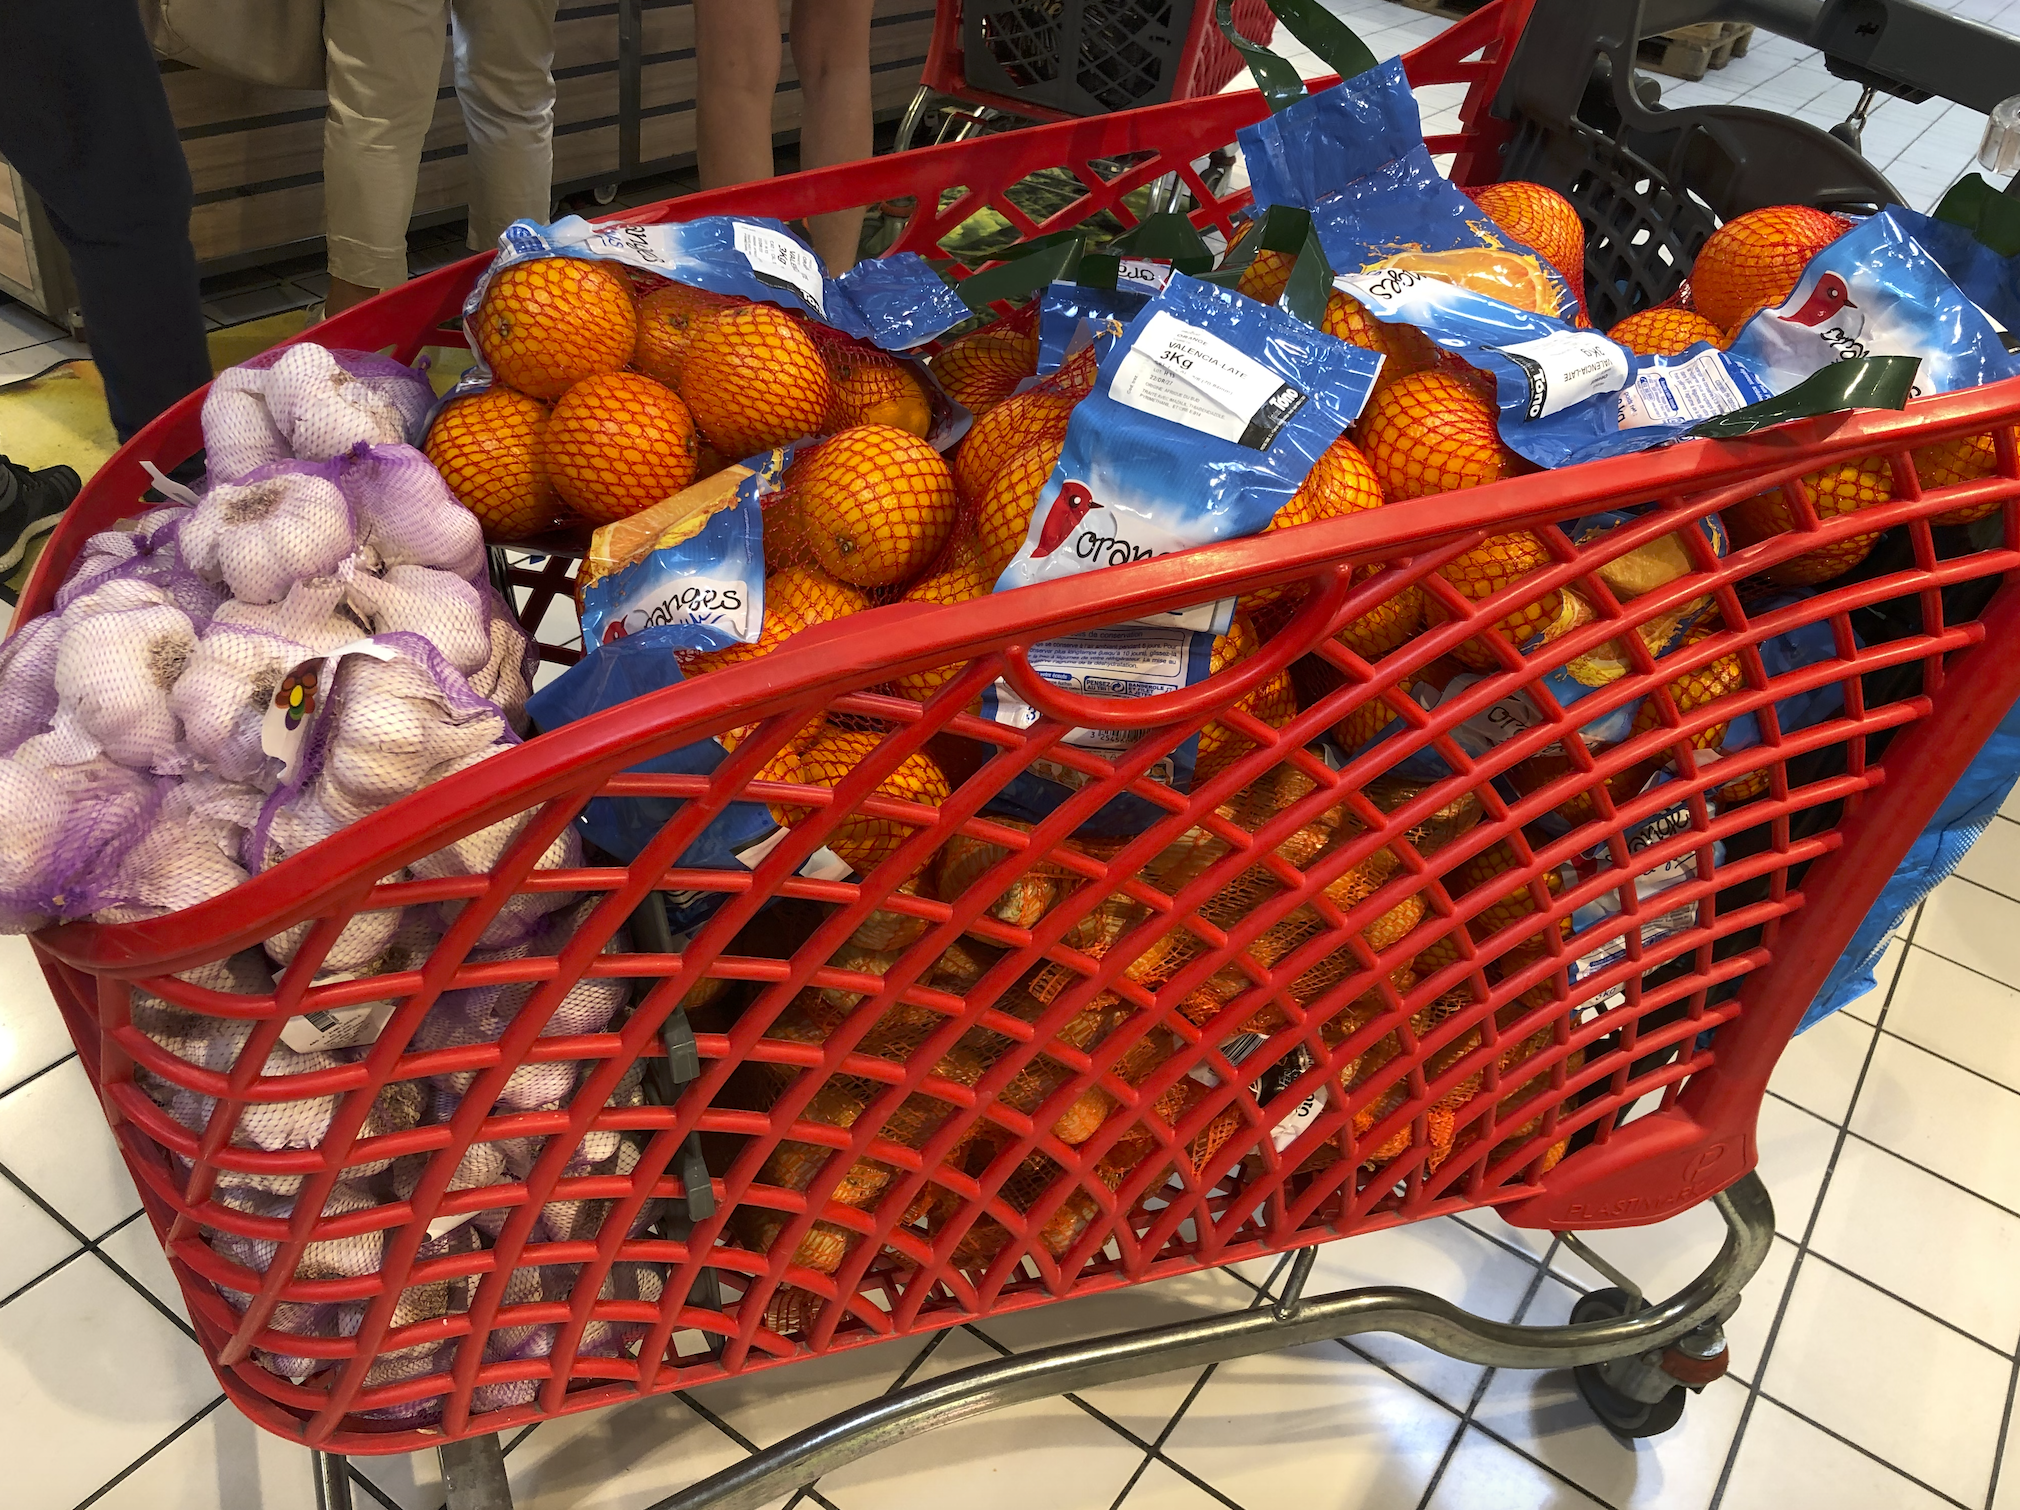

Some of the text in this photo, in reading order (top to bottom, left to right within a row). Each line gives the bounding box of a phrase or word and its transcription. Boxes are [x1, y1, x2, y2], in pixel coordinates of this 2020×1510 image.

[1176, 333, 1208, 346] ORANGE
[1160, 350, 1194, 371] 3Kg
[1168, 341, 1248, 379] VALENCIA-LATE
[1076, 531, 1170, 567] oran
[644, 587, 742, 630] anges
